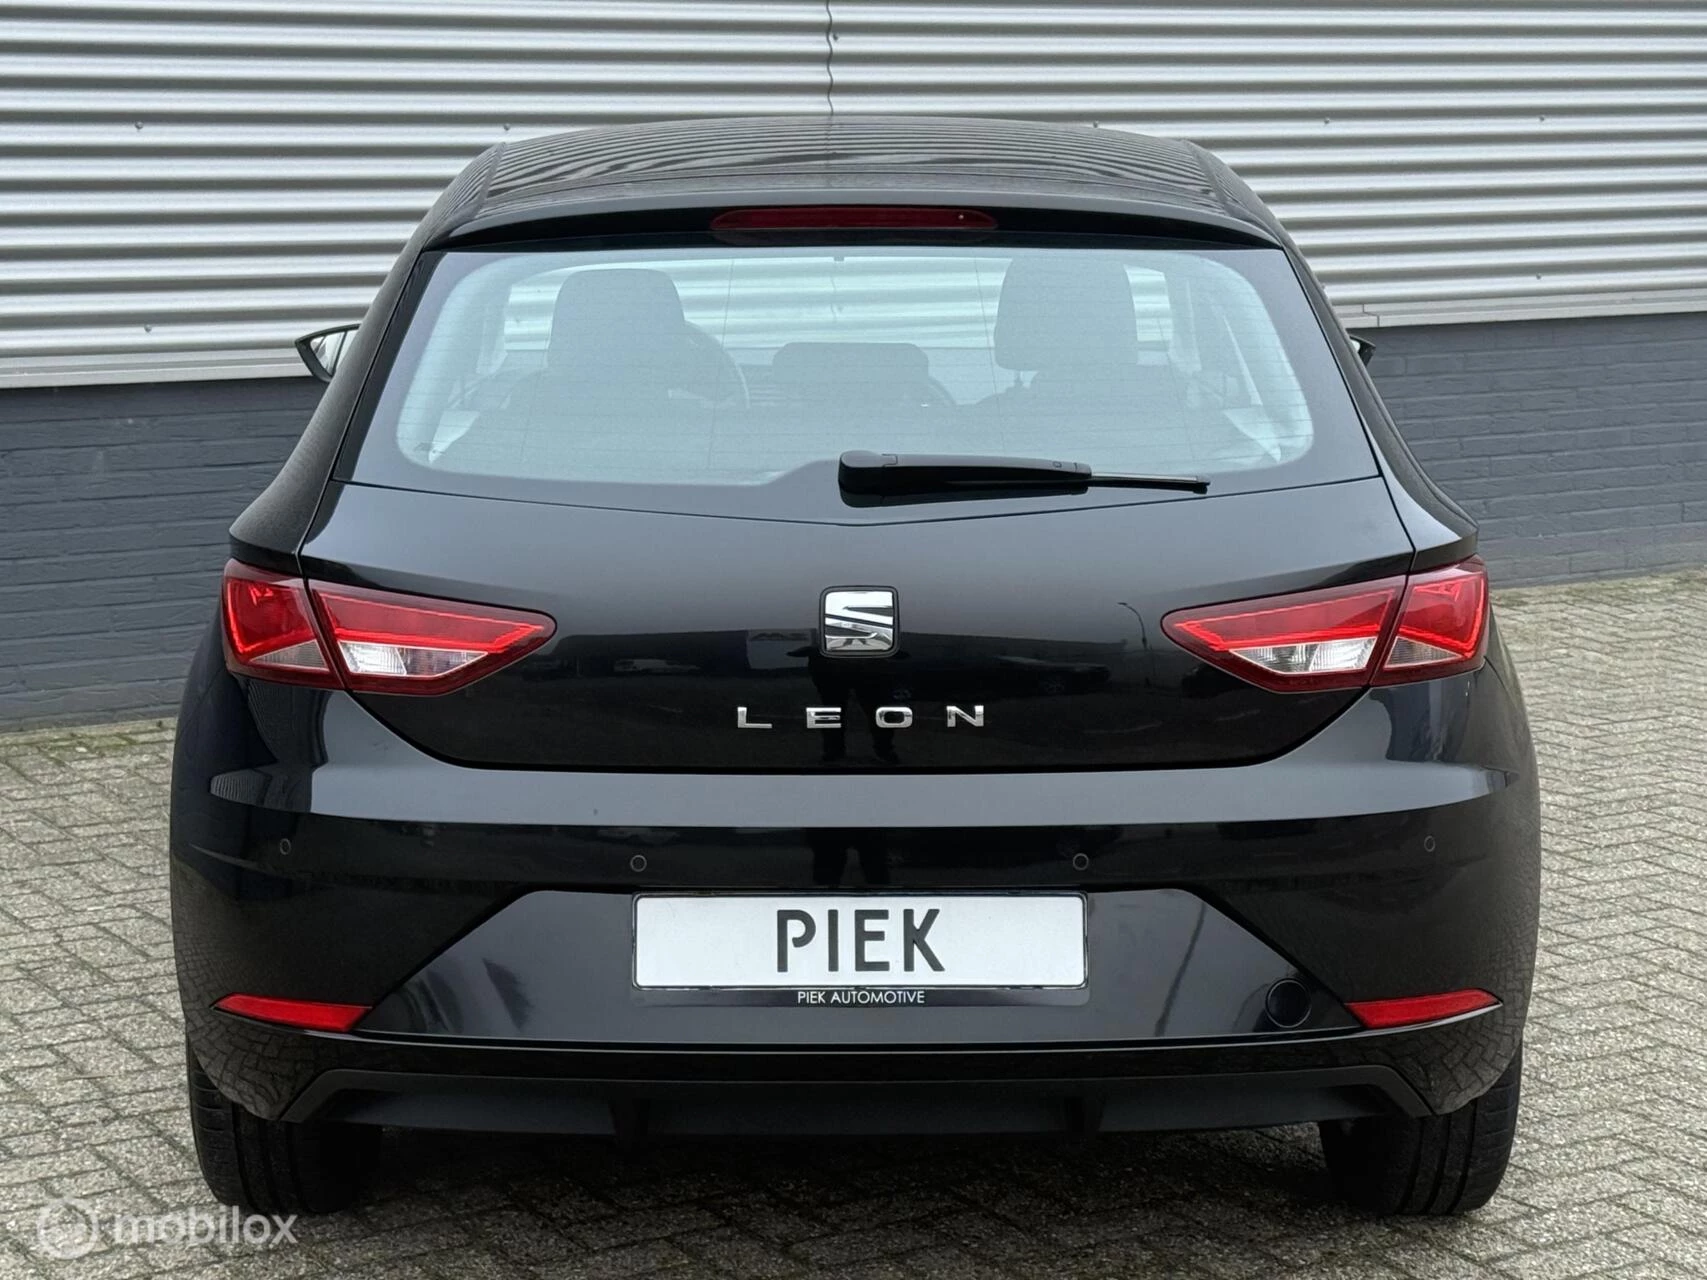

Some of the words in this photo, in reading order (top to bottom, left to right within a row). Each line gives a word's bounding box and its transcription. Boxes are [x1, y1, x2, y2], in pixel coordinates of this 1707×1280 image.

[737, 705, 985, 729] LEON
[777, 909, 945, 973] PIEK
[797, 990, 827, 1004] PIEK
[829, 990, 926, 1004] AUTOMOTIVE
